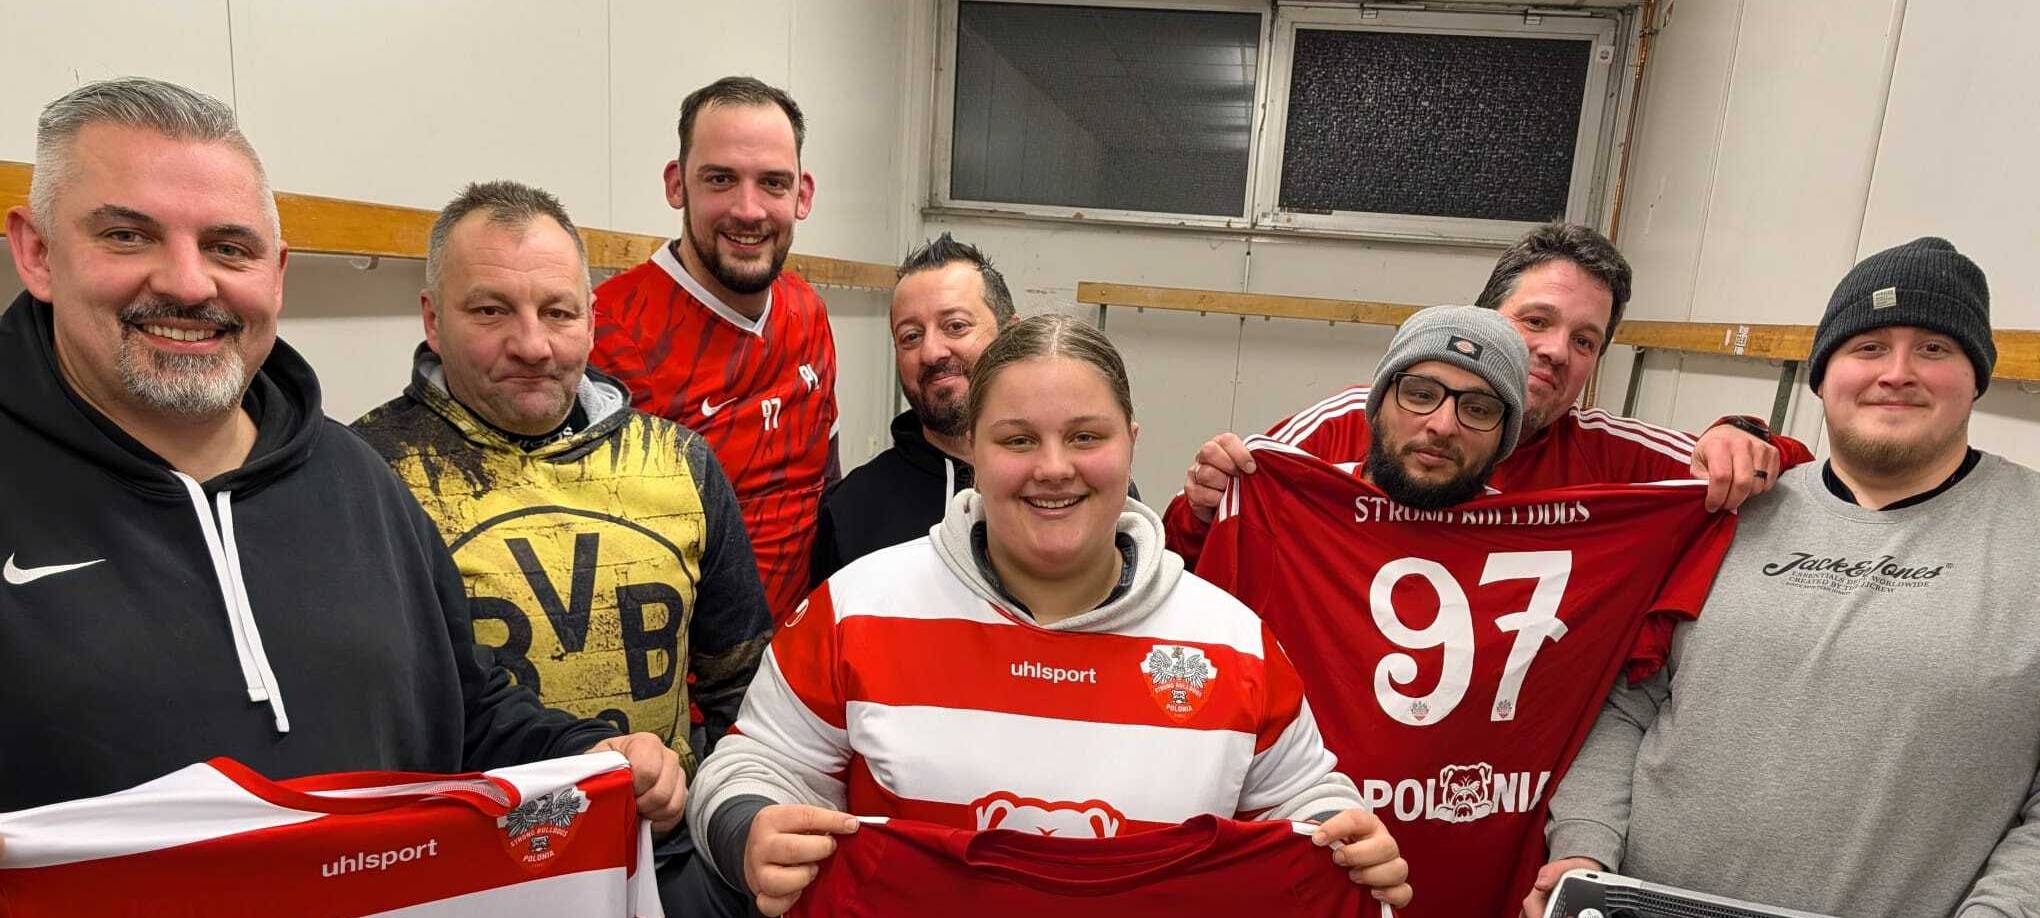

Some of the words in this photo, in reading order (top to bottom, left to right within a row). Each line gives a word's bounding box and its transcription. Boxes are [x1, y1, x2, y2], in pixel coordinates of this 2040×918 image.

[762, 397, 781, 431] 97
[471, 532, 684, 702] BVB
[1369, 550, 1573, 727] 97
[1011, 661, 1097, 684] uhlsport
[1363, 762, 1551, 824] POLNI
[322, 839, 438, 877] uhlsport
[522, 850, 556, 863] POLONIA
